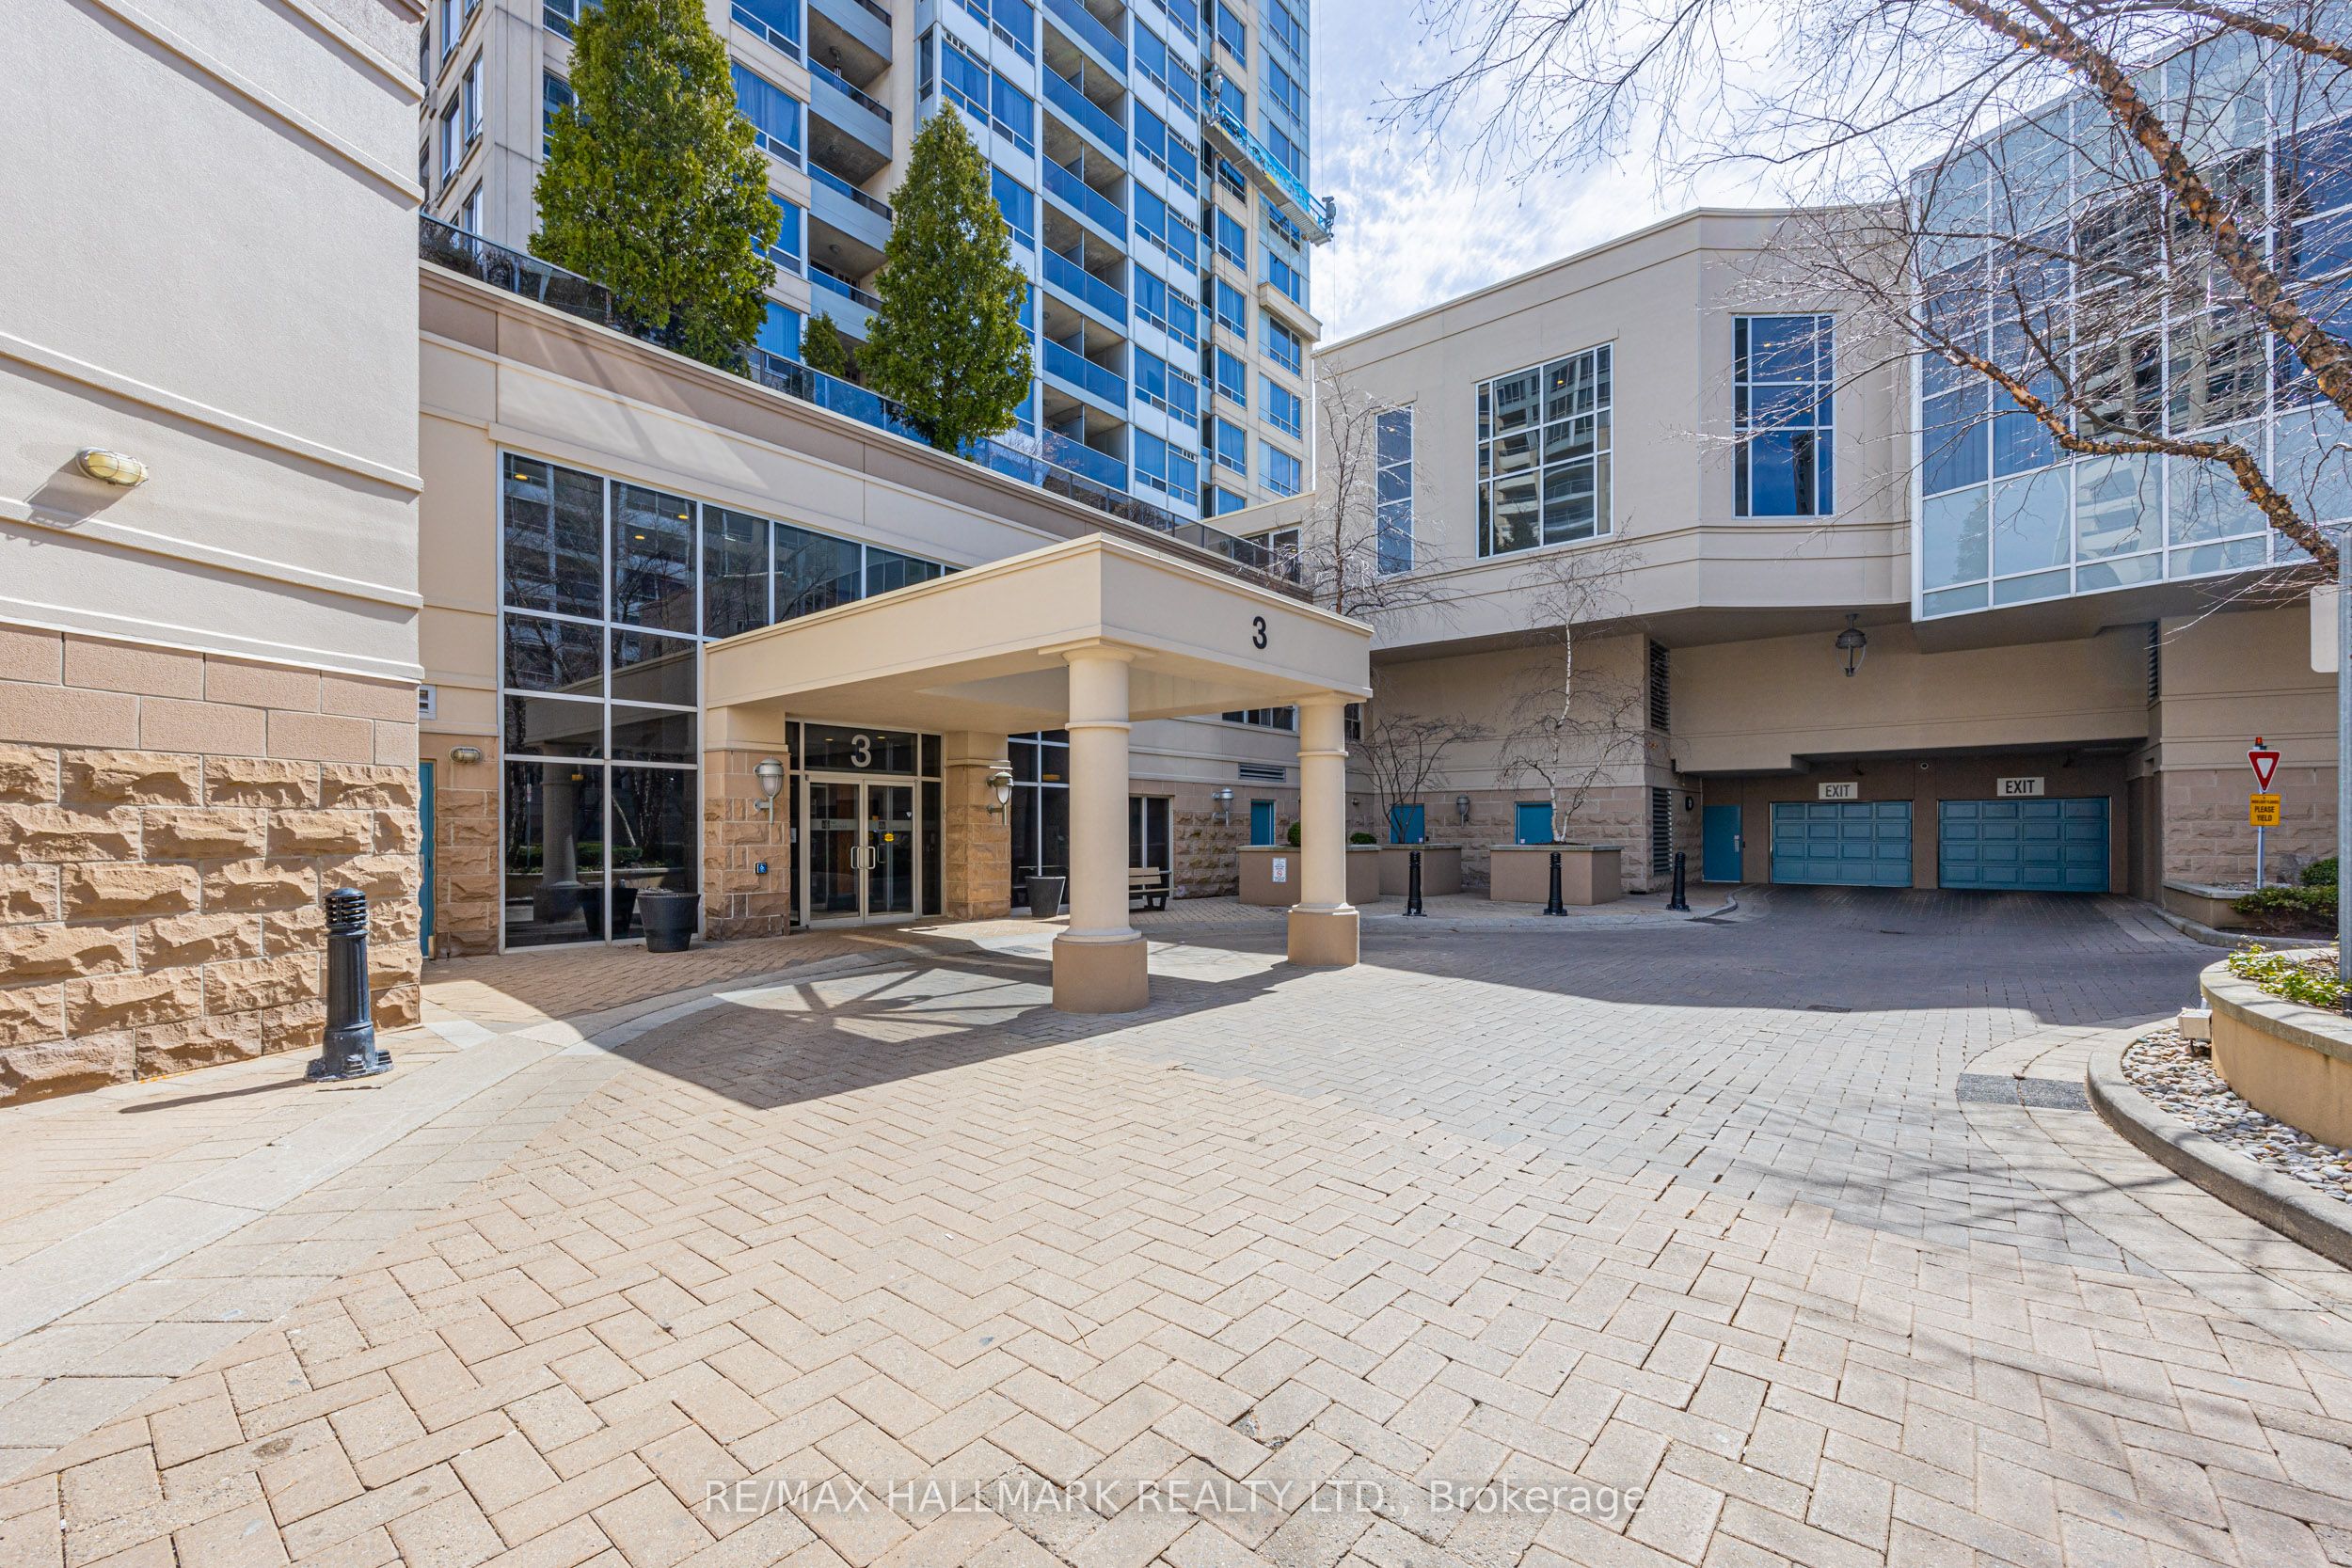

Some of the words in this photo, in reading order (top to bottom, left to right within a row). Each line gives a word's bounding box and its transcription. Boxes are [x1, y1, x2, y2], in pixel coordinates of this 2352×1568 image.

[1252, 616, 1267, 650] 3
[850, 734, 872, 768] 3
[1825, 784, 1851, 798] EXIT
[2006, 780, 2035, 794] EXIT
